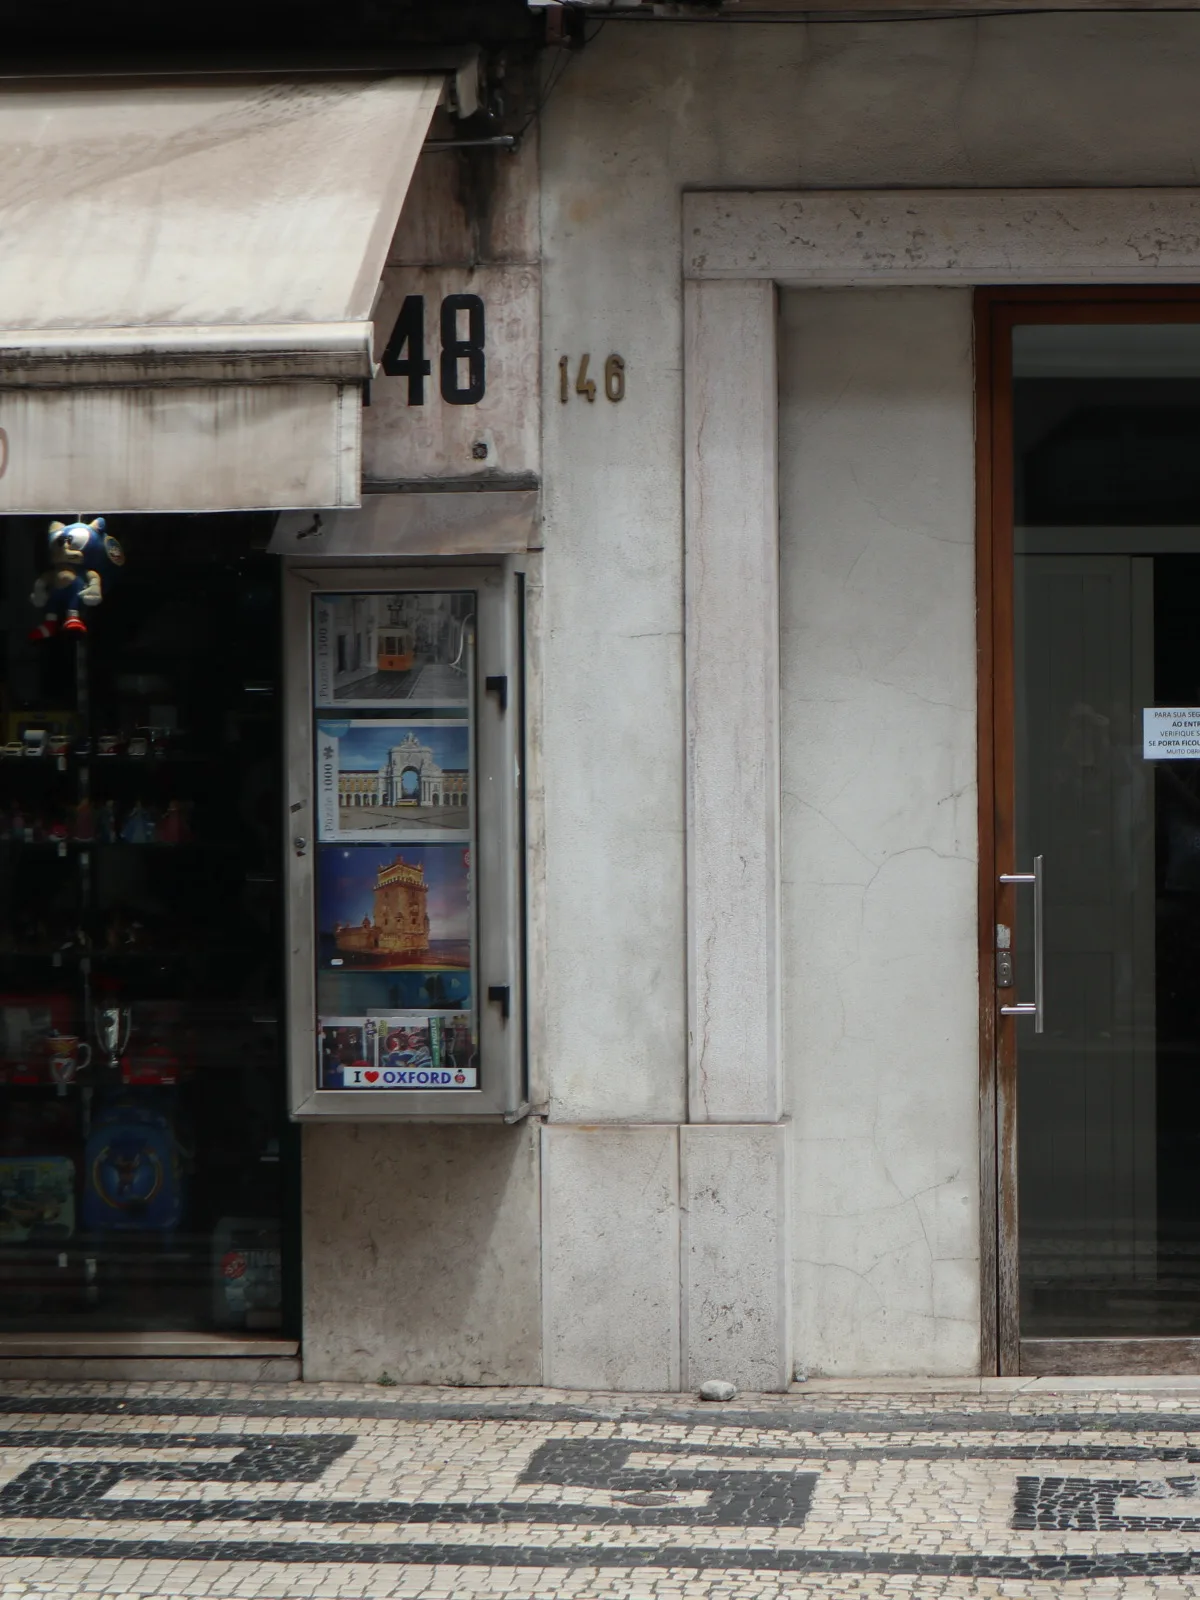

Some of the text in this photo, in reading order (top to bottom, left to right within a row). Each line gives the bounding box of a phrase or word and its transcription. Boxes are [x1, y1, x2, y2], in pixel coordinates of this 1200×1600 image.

[363, 294, 486, 406] 48
[558, 353, 626, 404] 146
[1160, 730, 1195, 738] VERIFIQUE
[323, 763, 333, 832] Puzzle 1000
[353, 1070, 451, 1084] I OXFORD
